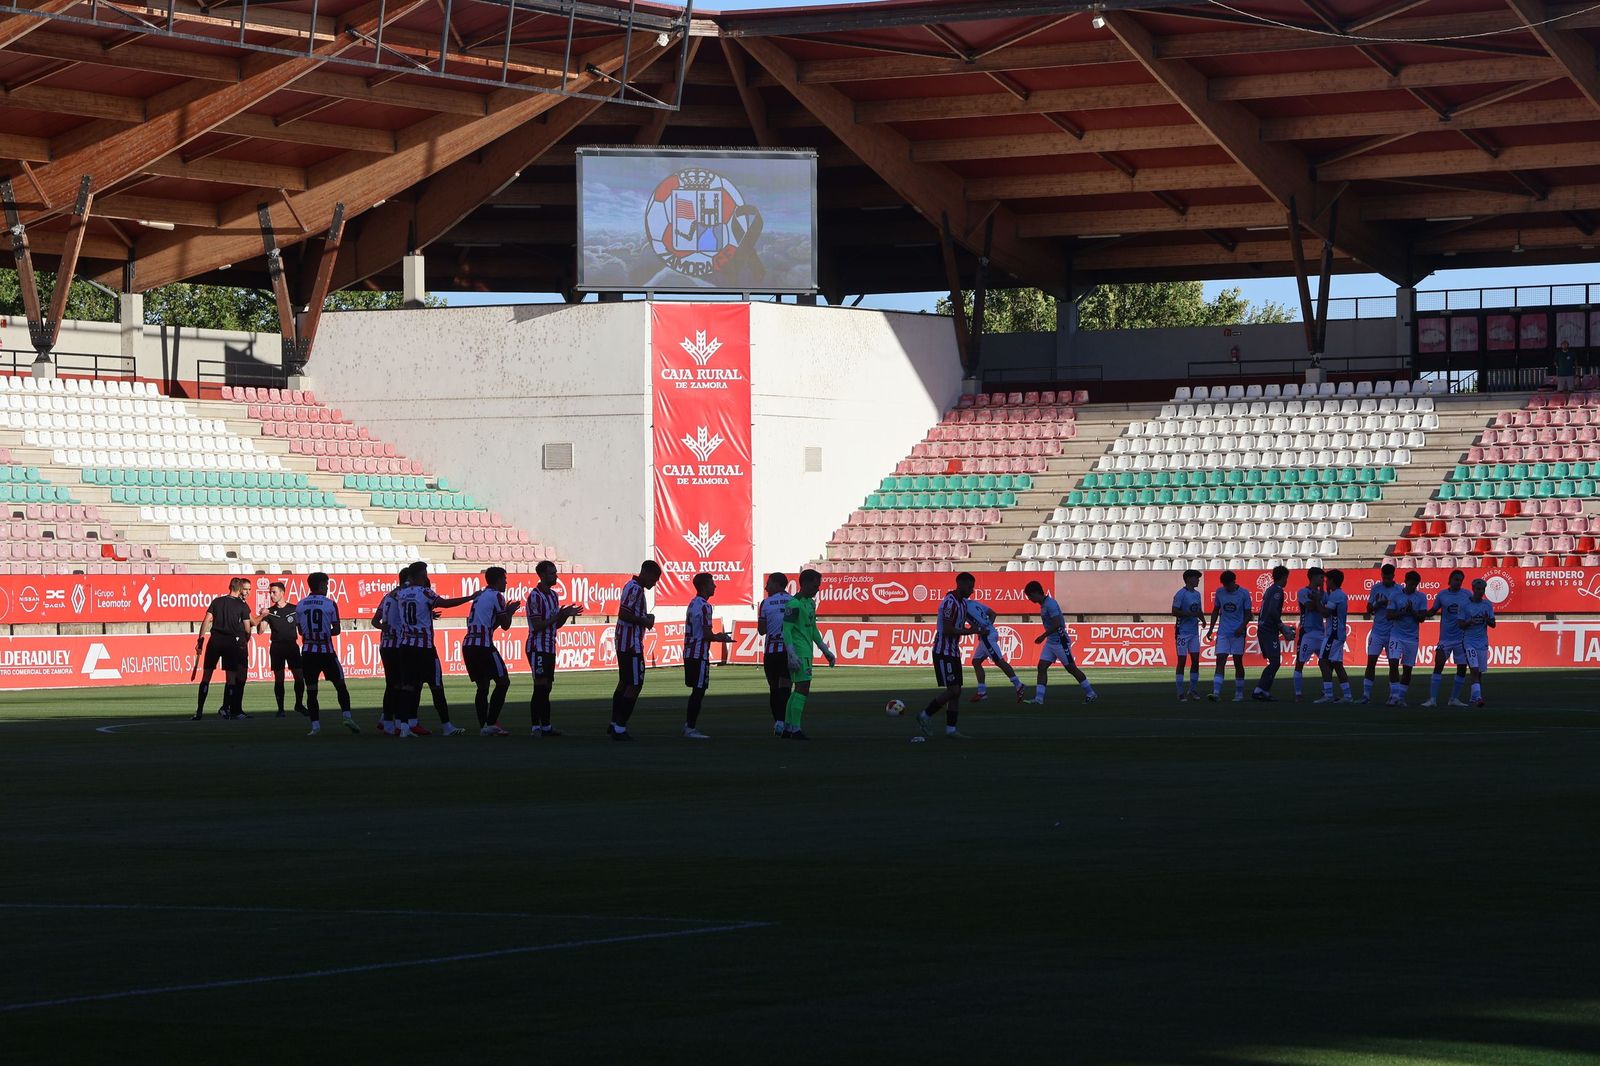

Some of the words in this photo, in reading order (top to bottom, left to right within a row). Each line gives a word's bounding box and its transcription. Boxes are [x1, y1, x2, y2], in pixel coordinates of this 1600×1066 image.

[661, 369, 694, 380] CAJA
[697, 369, 742, 380] RURAL
[662, 465, 695, 476] CAJA
[698, 465, 743, 476] RURAL
[664, 561, 696, 572] CAJA
[699, 561, 744, 572] RURAL
[1526, 571, 1584, 579] MERENDERO
[97, 590, 114, 598] Grupo
[930, 589, 944, 600] EL
[975, 589, 993, 600] DE
[97, 599, 131, 608] Leomotor
[401, 601, 417, 626] 10
[304, 609, 323, 632] 19
[443, 631, 462, 662] La
[1389, 641, 1399, 650] 21
[1081, 648, 1167, 665] ZAMORA
[1467, 649, 1477, 658] 19
[121, 656, 183, 674] AISLAPRIETO,
[537, 656, 543, 666] 2
[350, 667, 372, 675] Correo
